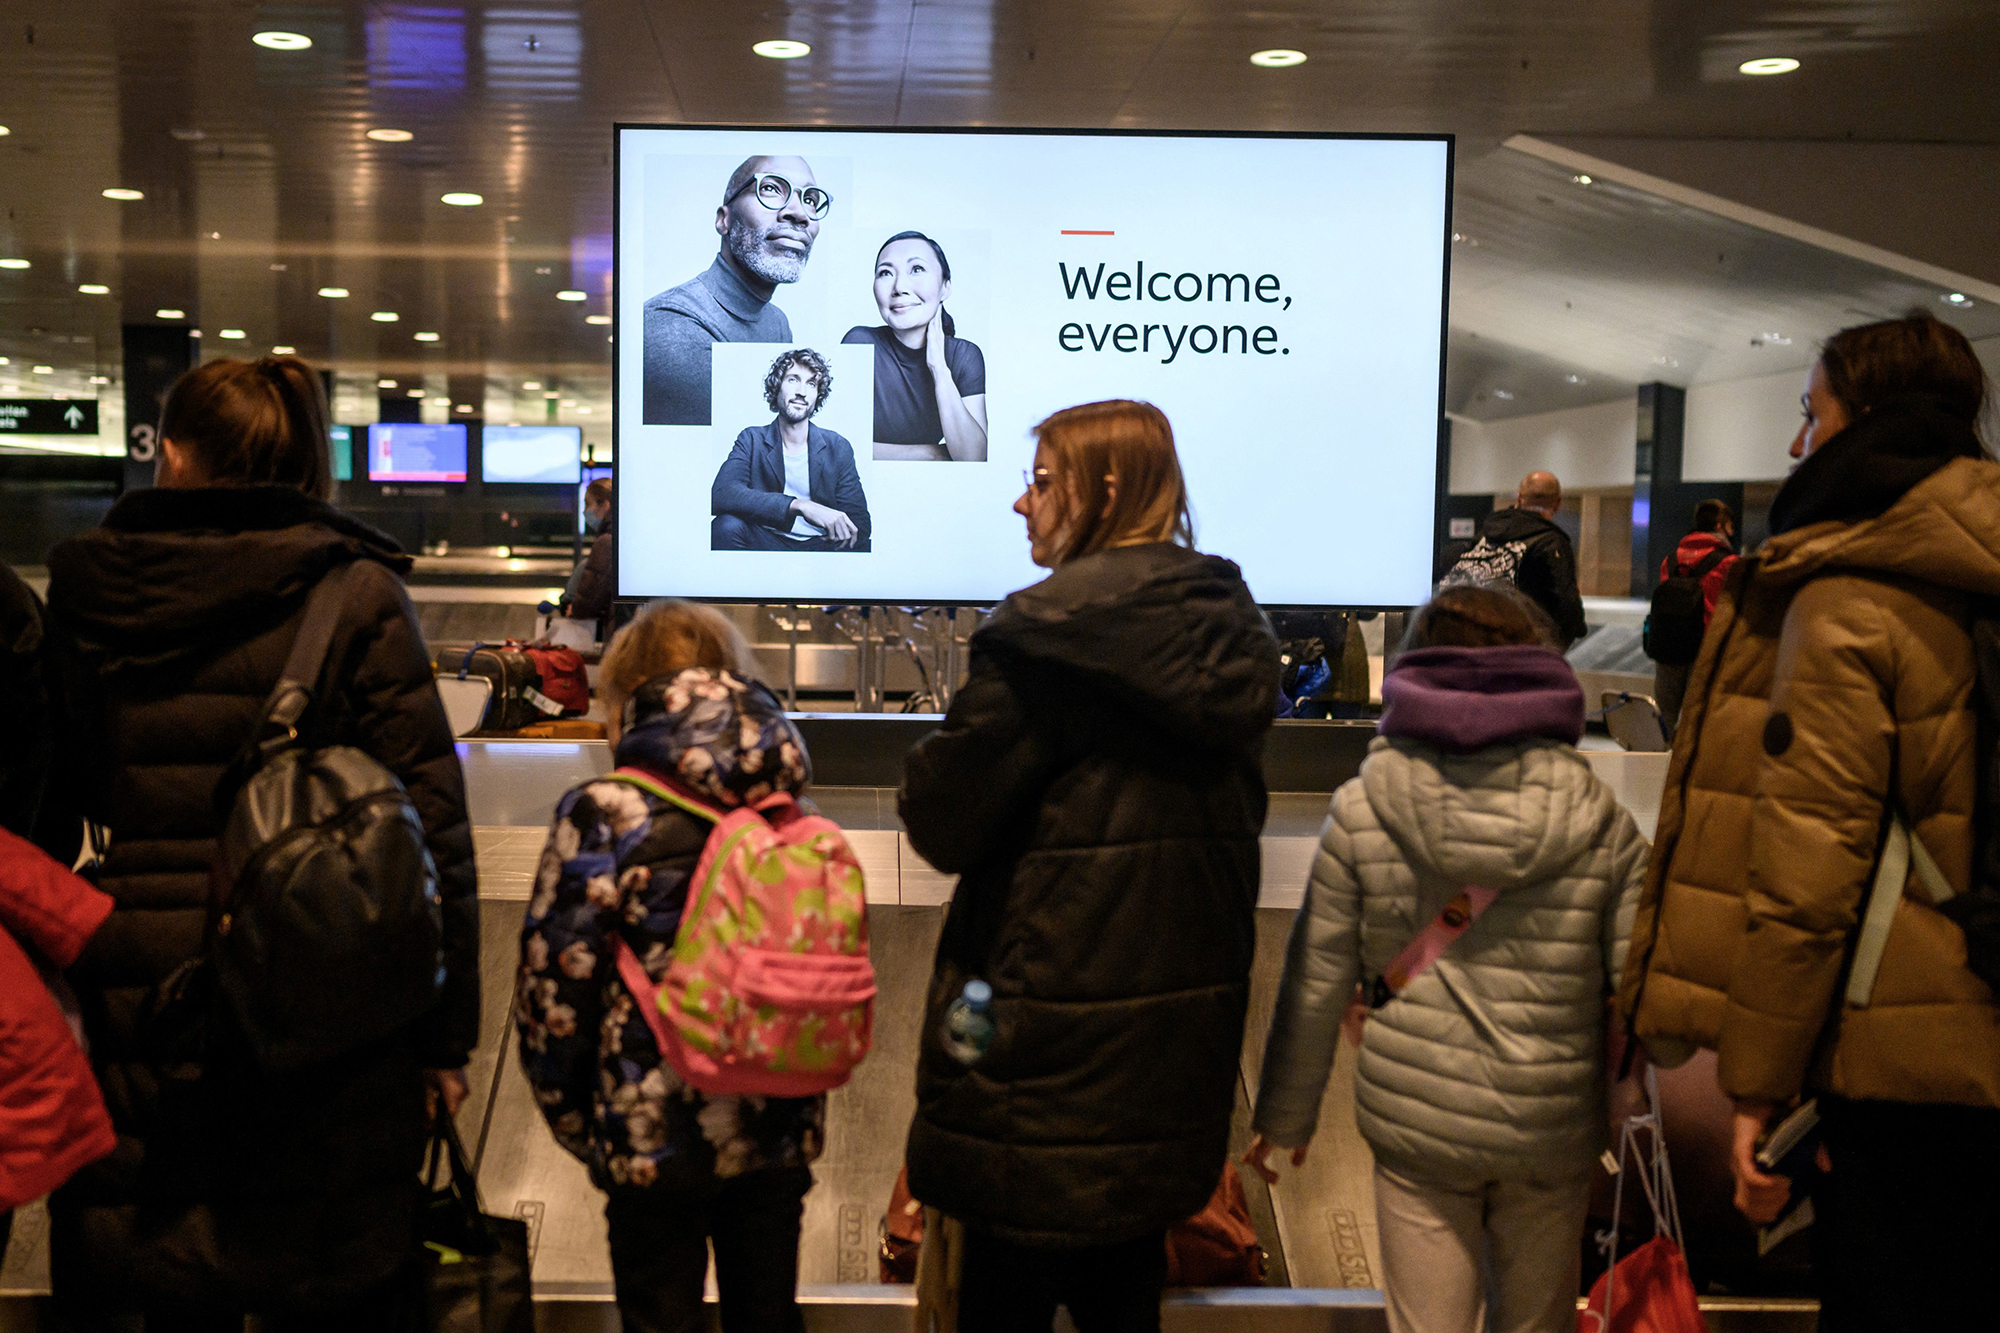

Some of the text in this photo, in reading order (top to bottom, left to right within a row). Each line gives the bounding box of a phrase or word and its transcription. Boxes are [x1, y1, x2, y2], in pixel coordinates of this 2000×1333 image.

[1058, 260, 1292, 311] Welcome,
[1058, 322, 1290, 364] everyone.
[130, 423, 156, 462] 3
